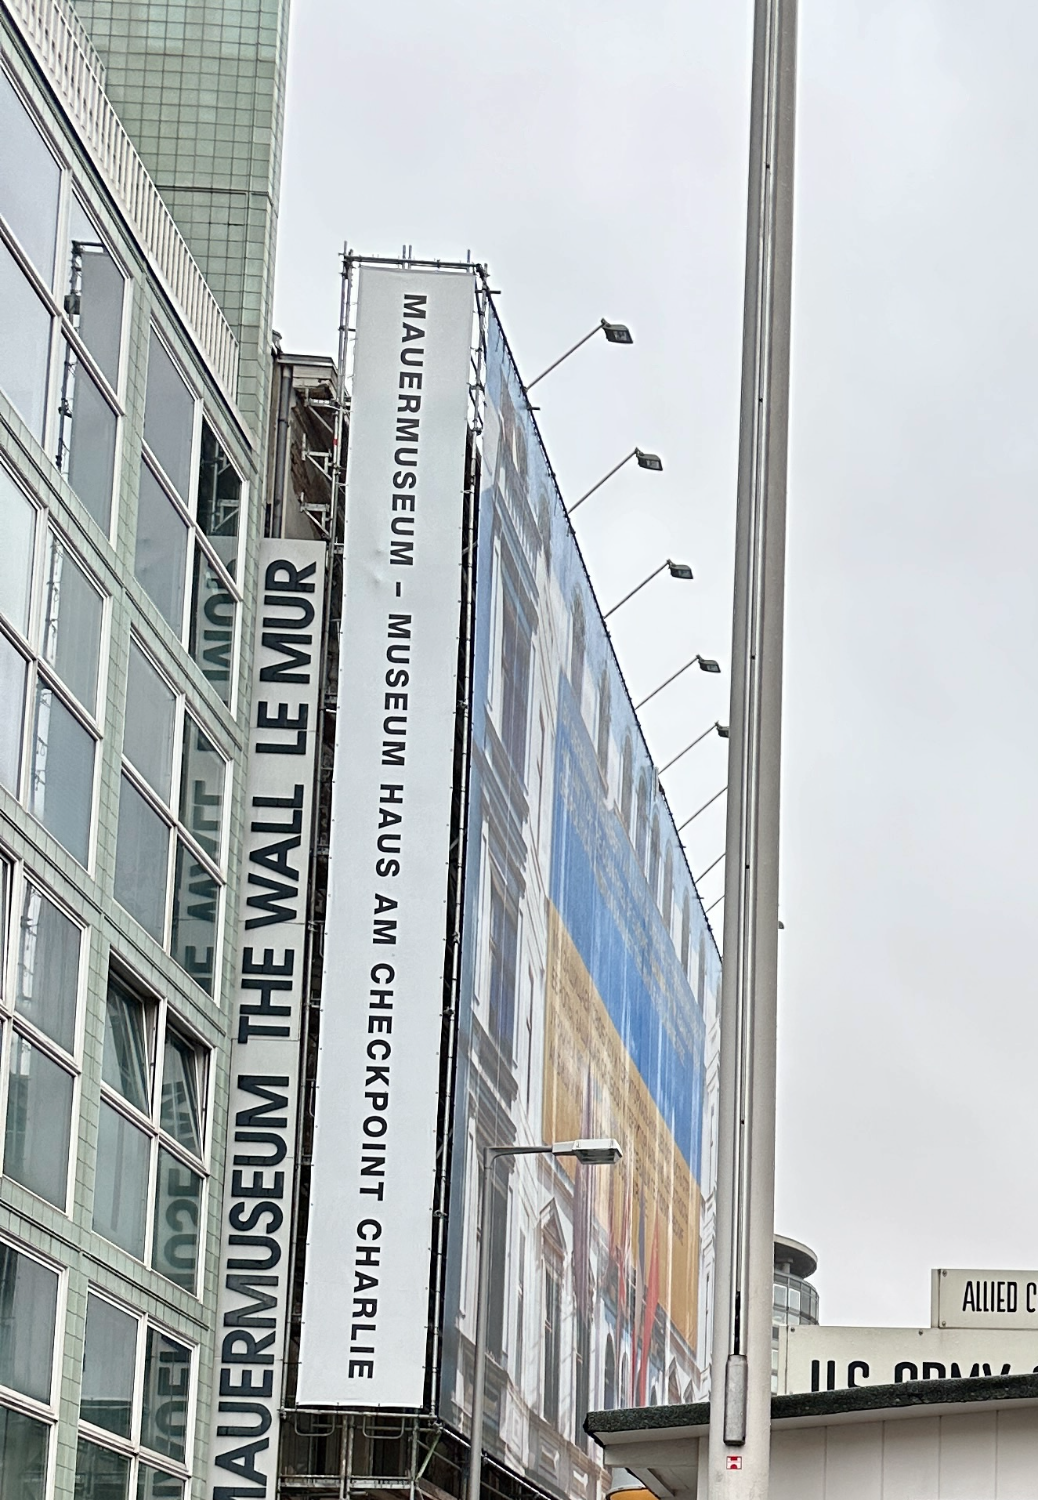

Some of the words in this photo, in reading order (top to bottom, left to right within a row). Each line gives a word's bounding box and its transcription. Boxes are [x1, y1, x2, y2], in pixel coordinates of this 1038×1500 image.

[389, 292, 428, 567] MAUERMUSEUM
[258, 557, 317, 684] MUR
[255, 700, 308, 755] LE
[381, 612, 412, 768] MUSEUM
[243, 782, 305, 932] WALL
[374, 784, 405, 879] HAUS
[372, 897, 399, 945] AM
[237, 945, 295, 1045] THE
[357, 963, 396, 1202] CHECKPOINT
[347, 1219, 383, 1381] CHARLIE
[962, 1280, 1018, 1313] ALLIED
